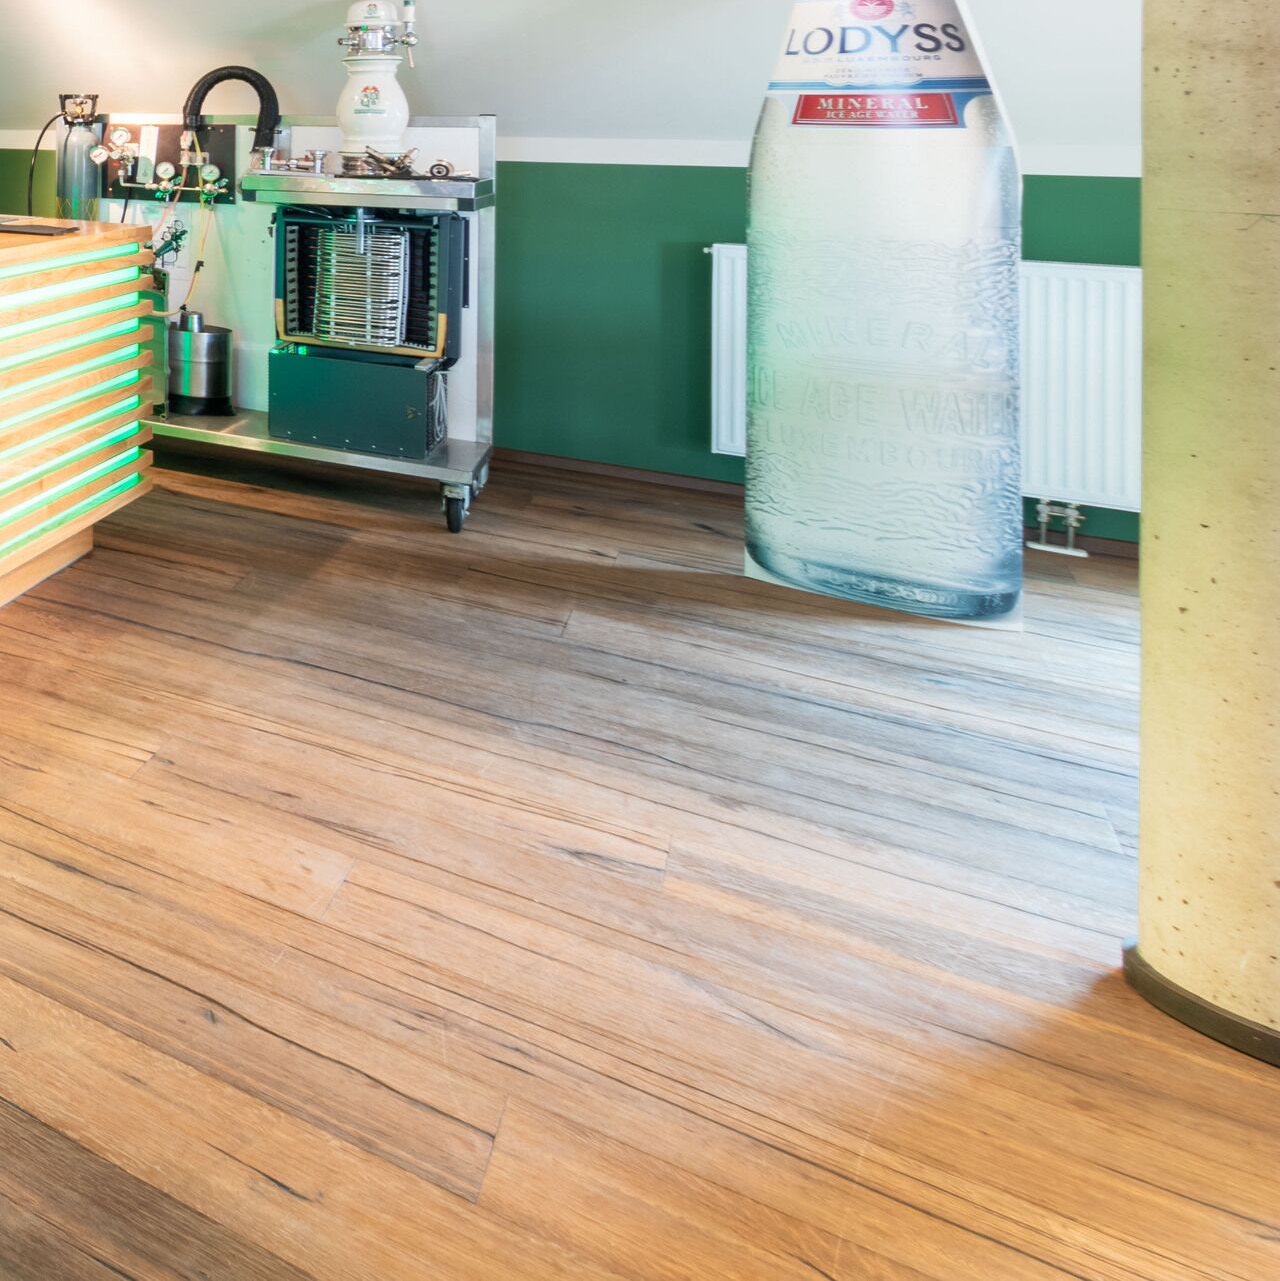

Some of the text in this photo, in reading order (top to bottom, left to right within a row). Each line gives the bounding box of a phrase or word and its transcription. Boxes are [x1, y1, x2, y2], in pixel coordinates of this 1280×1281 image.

[784, 22, 966, 56] LODYSS
[816, 96, 929, 110] MINERAL
[825, 109, 919, 119] ICE AGE WATER
[776, 317, 991, 369] MINERAL
[801, 379, 879, 425] AGE
